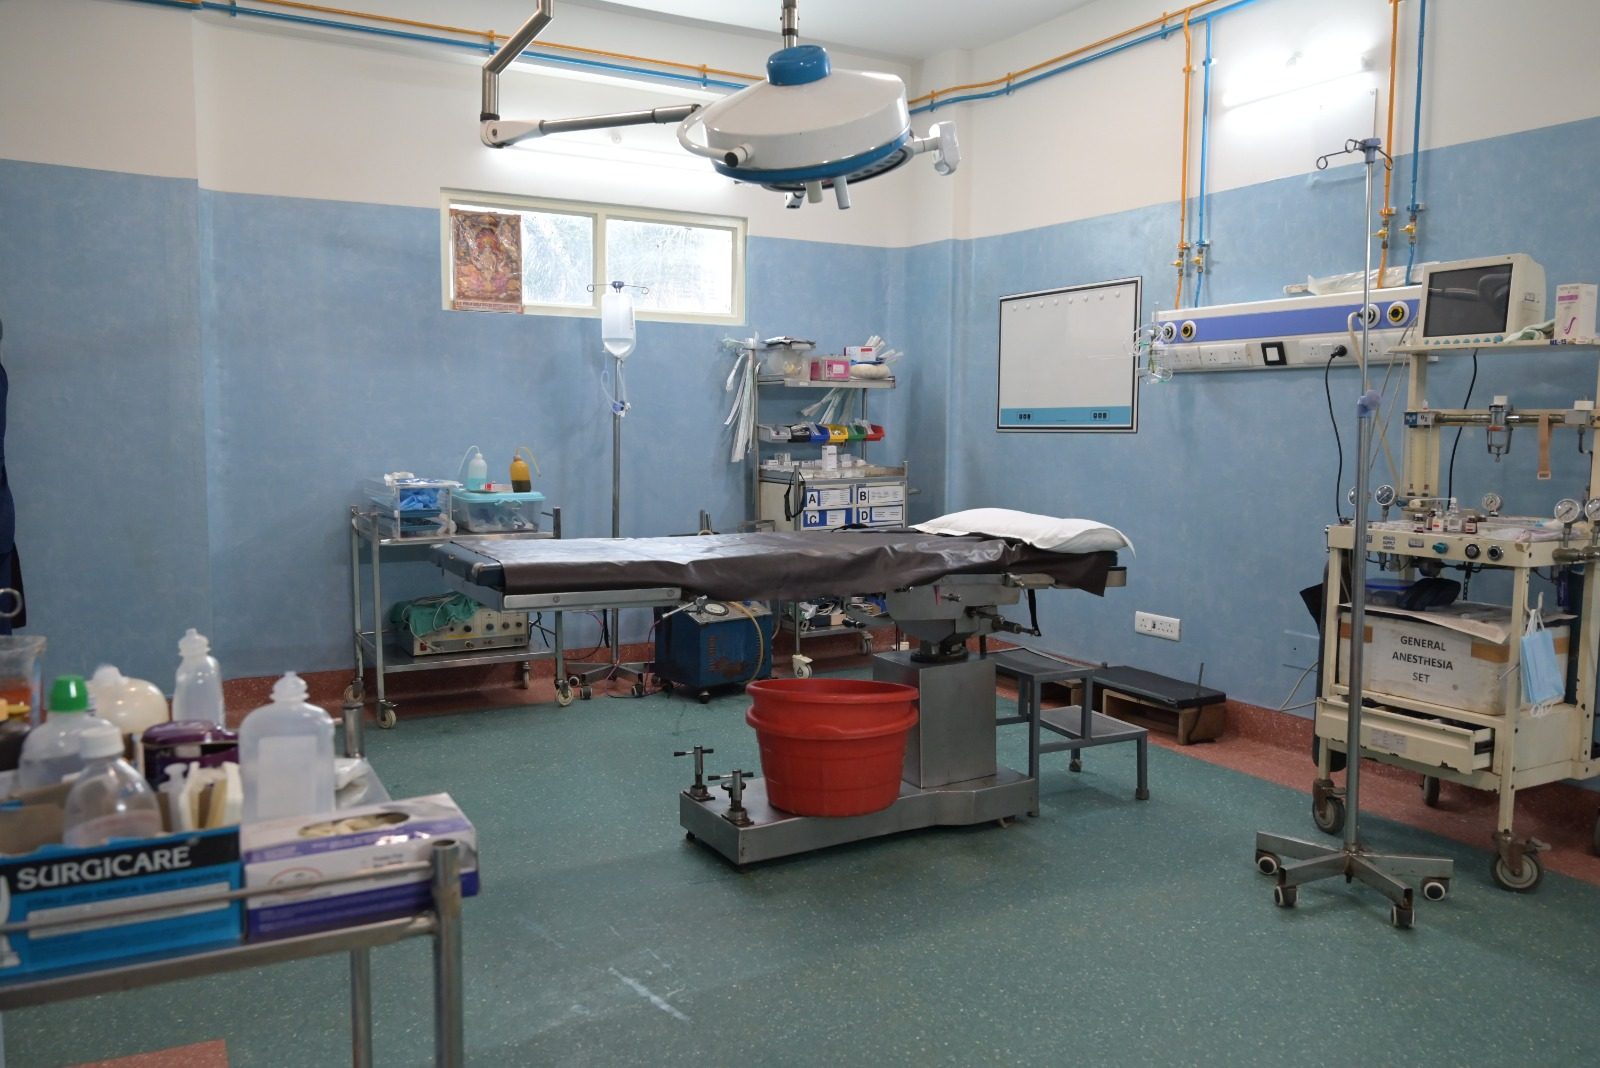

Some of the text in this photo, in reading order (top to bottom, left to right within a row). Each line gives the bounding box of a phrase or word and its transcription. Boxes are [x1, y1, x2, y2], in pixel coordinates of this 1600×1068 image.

[808, 493, 817, 504] A
[859, 491, 867, 501] B
[809, 514, 817, 524] C
[861, 511, 868, 521] D
[1400, 635, 1446, 652] GENERAL
[1392, 651, 1454, 671] ANESTHESIA
[1412, 672, 1431, 684] SET
[17, 846, 191, 891] SURGICARE
